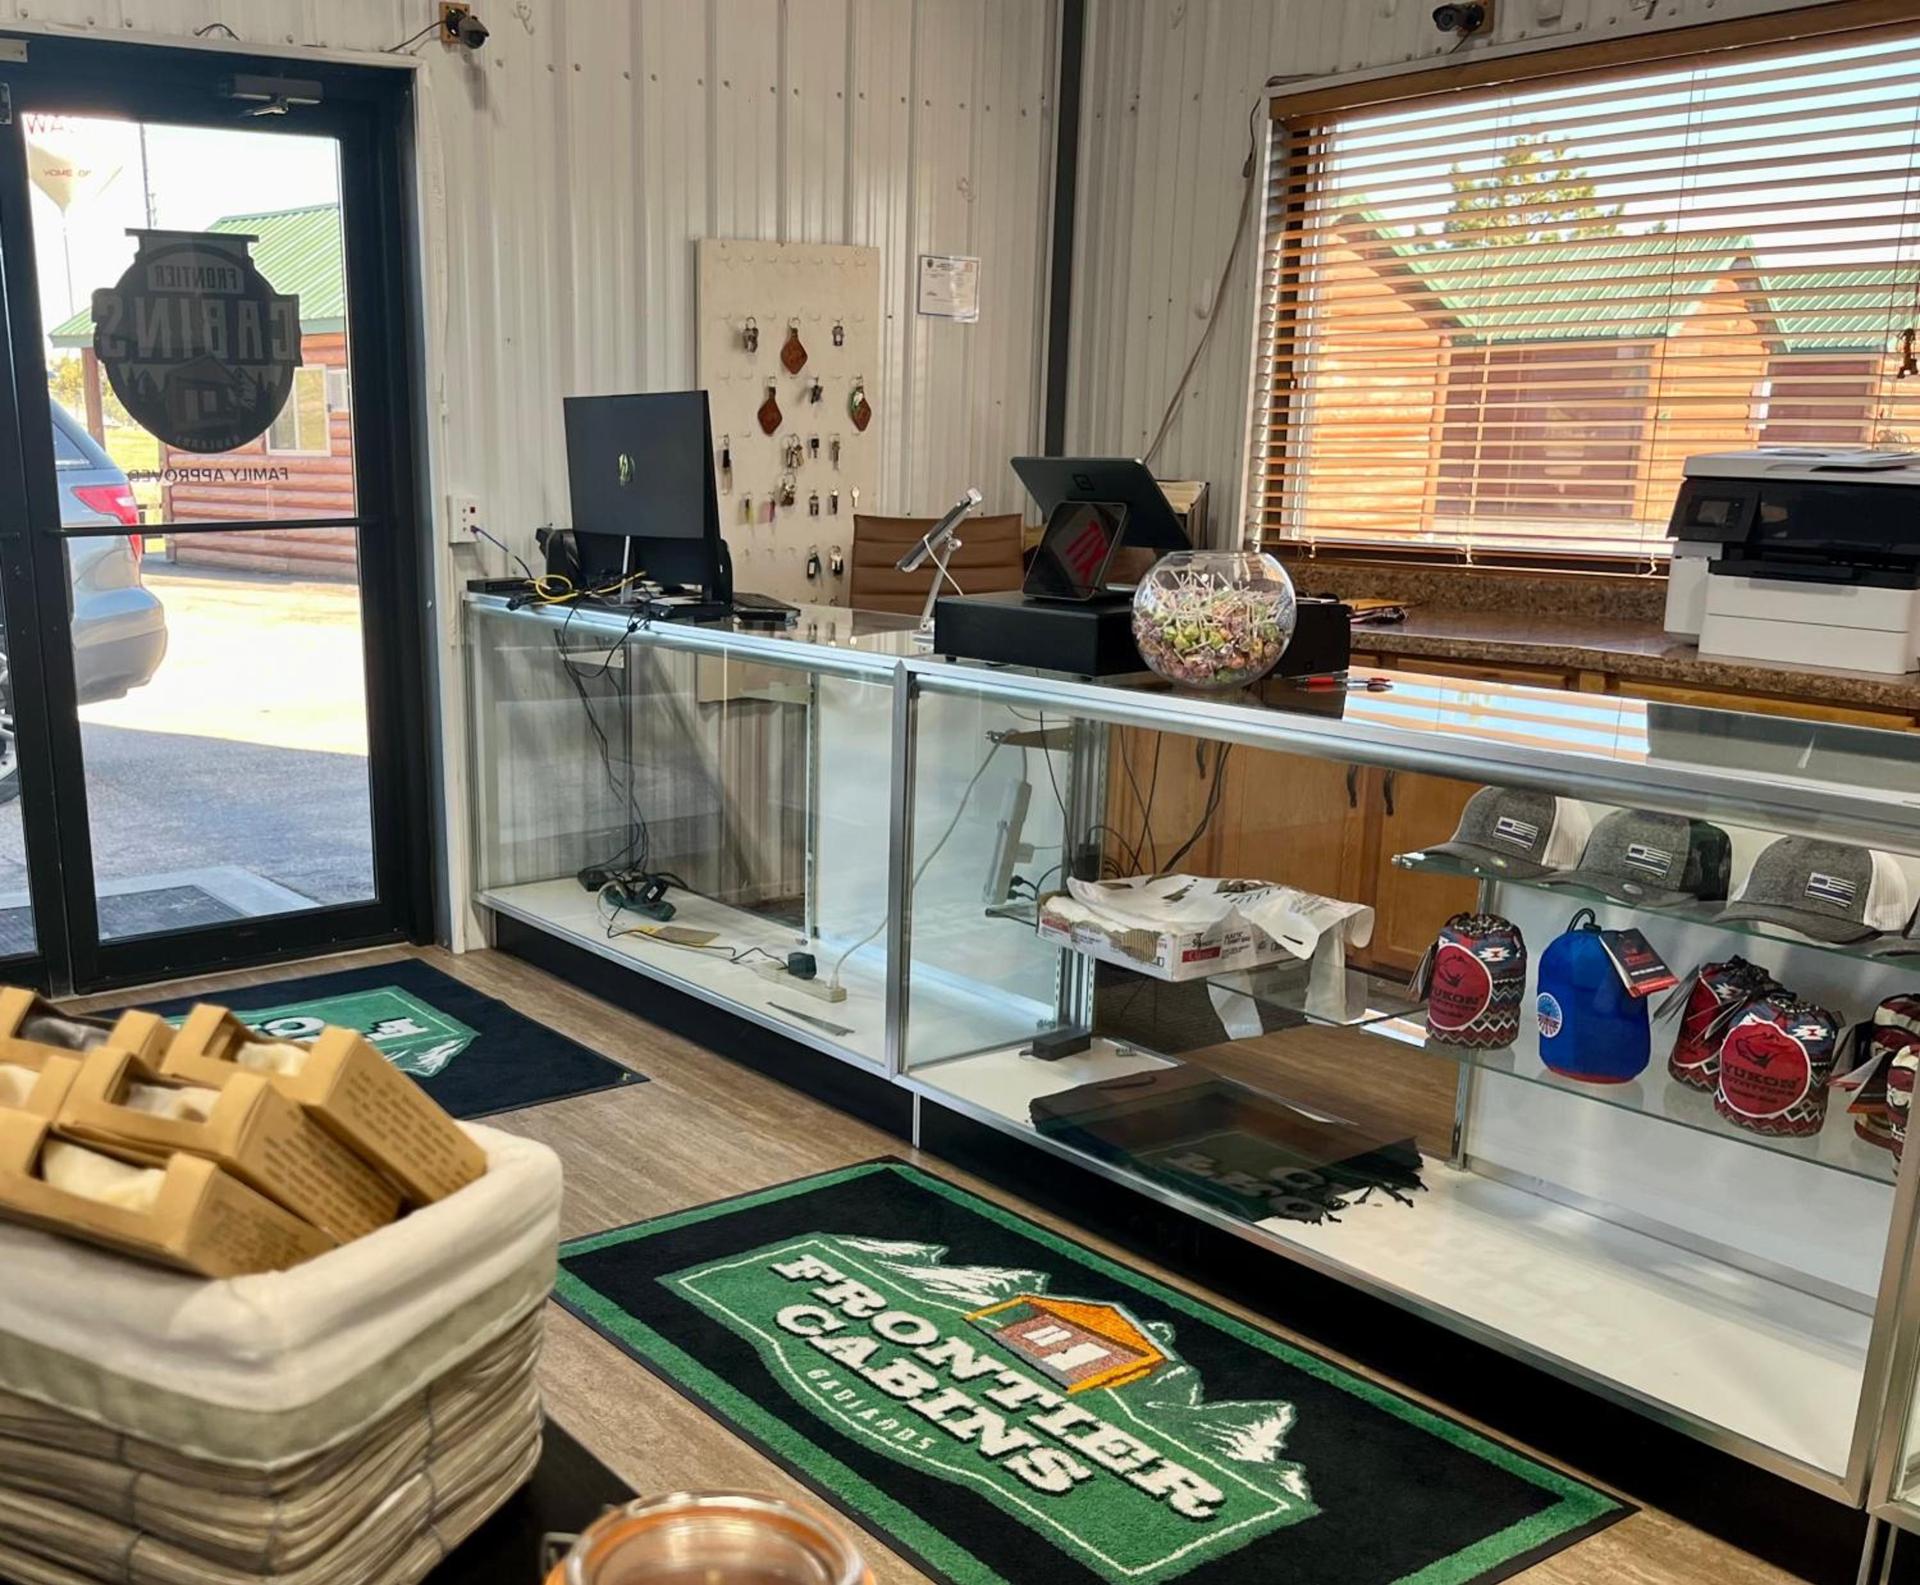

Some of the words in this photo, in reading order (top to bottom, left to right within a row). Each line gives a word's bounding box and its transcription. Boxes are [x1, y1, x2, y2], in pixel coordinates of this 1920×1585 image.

[1433, 988, 1480, 1006] UKON
[1723, 1062, 1797, 1090] YUKON
[771, 1254, 1226, 1520] FRONTIER
[776, 1304, 1094, 1494] CABINS
[807, 1369, 937, 1451] BADLANDS
